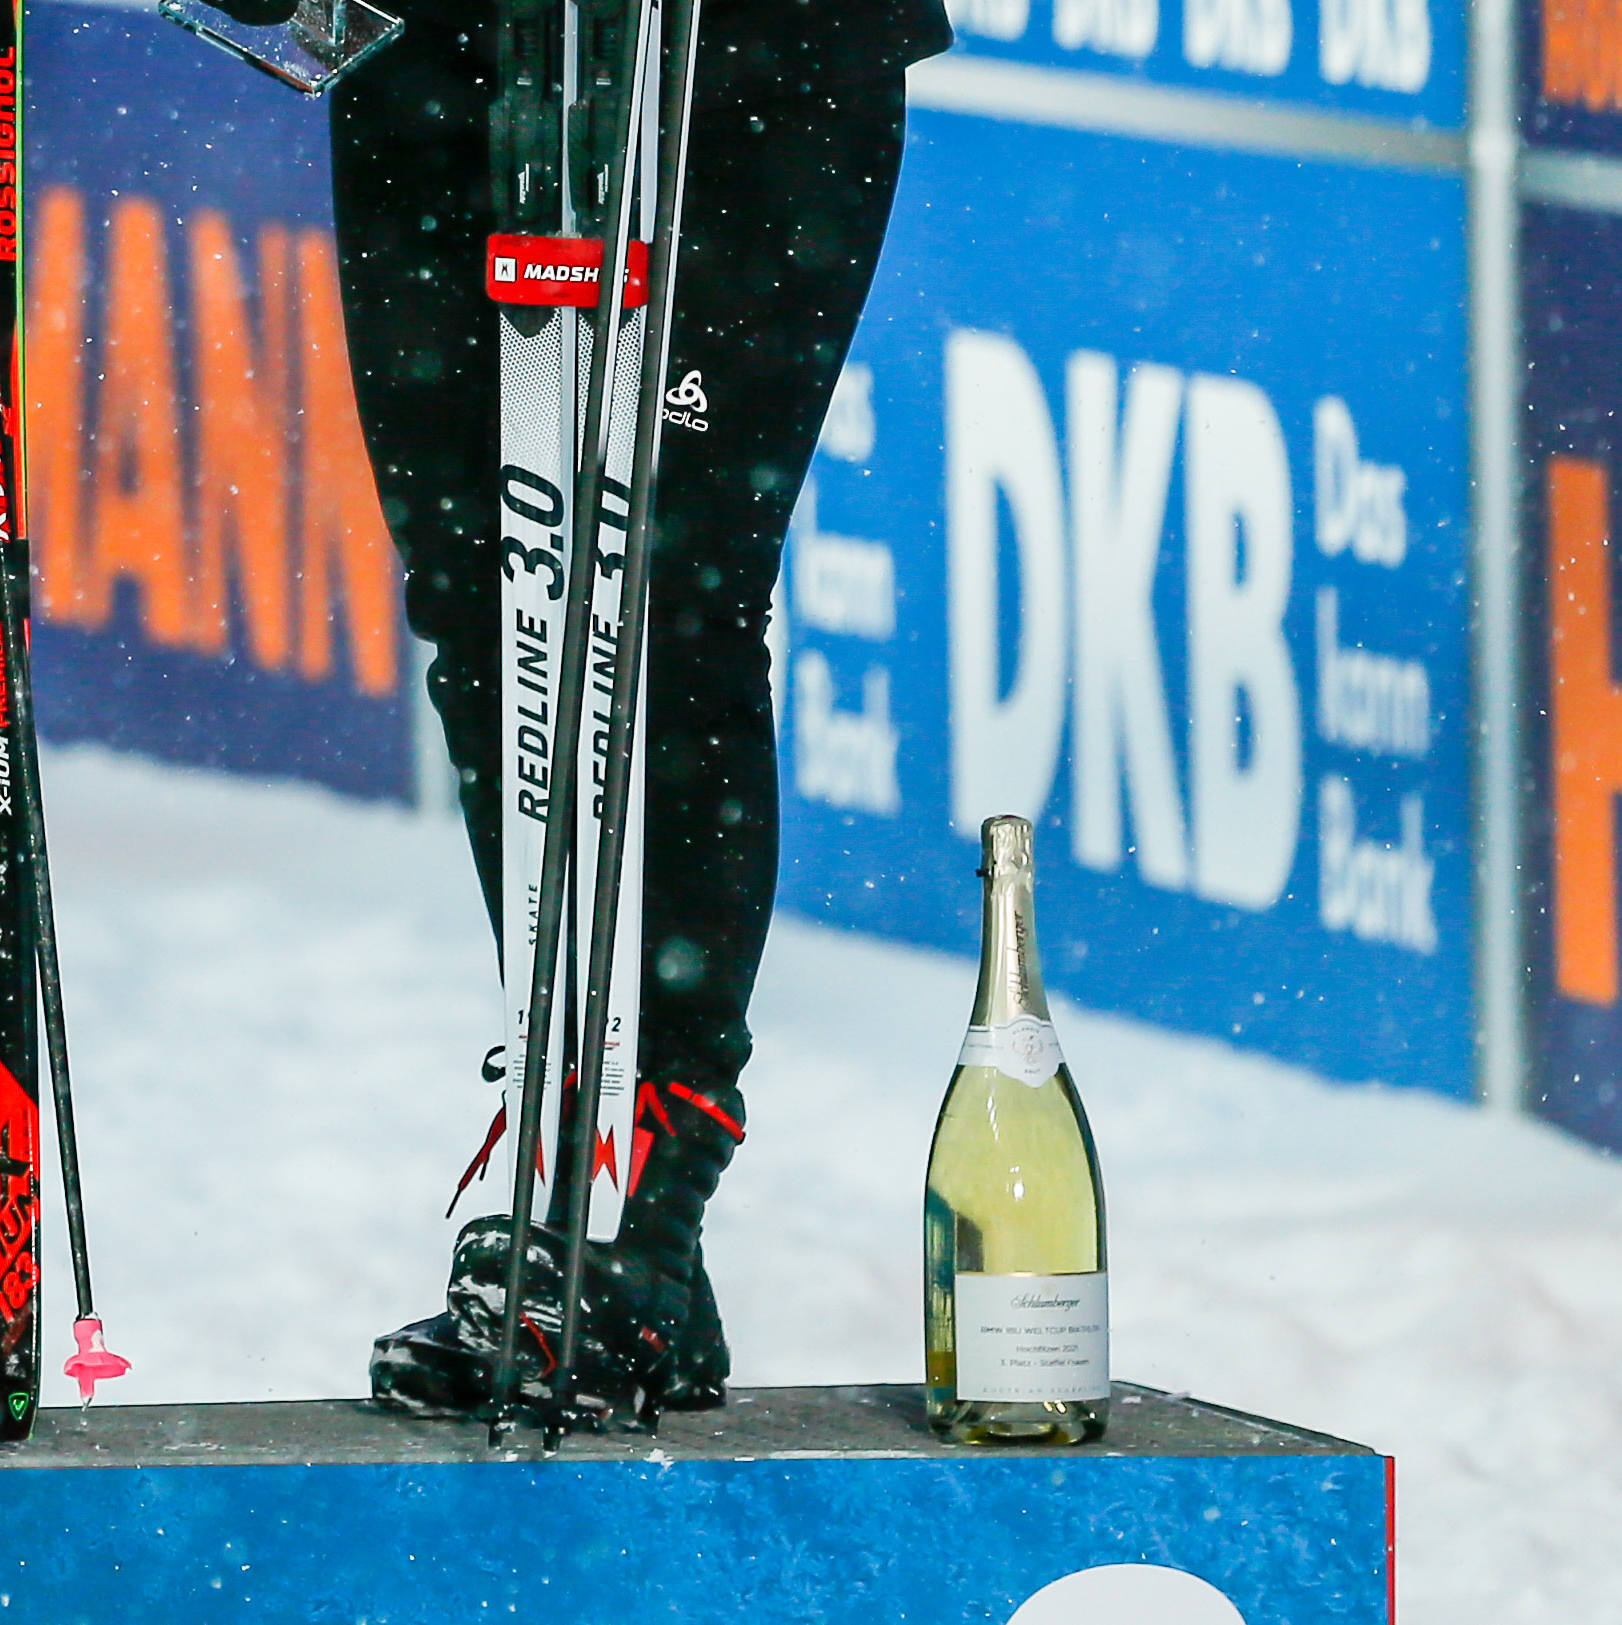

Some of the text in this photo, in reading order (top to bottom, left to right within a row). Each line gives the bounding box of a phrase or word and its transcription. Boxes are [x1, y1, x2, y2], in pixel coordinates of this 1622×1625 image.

[1314, 395, 1406, 567] Das
[500, 463, 565, 826] REDLINE 3.0
[945, 327, 1301, 912] DKB
[1011, 1293, 1081, 1312] Schlumberger
